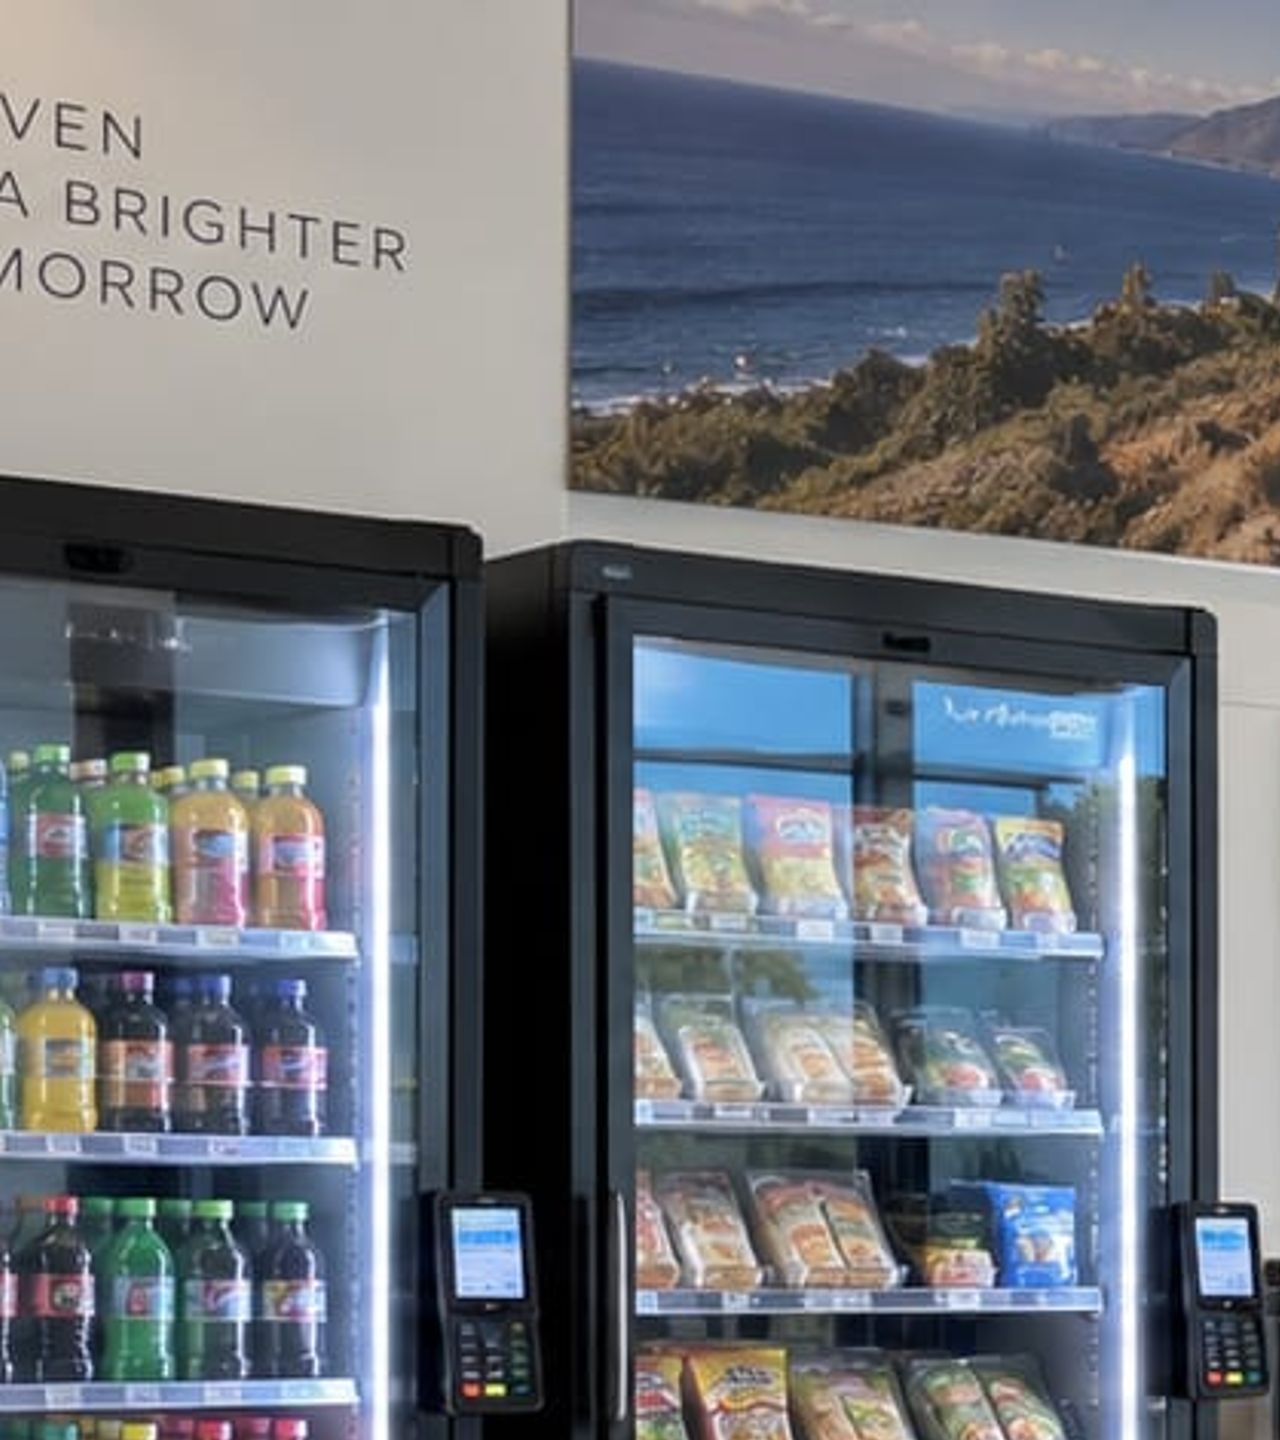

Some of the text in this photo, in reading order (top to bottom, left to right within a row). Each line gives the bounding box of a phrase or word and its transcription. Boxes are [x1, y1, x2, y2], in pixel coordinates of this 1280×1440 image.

[0, 92, 142, 160] VEN
[0, 170, 406, 273] A BRIGHTER
